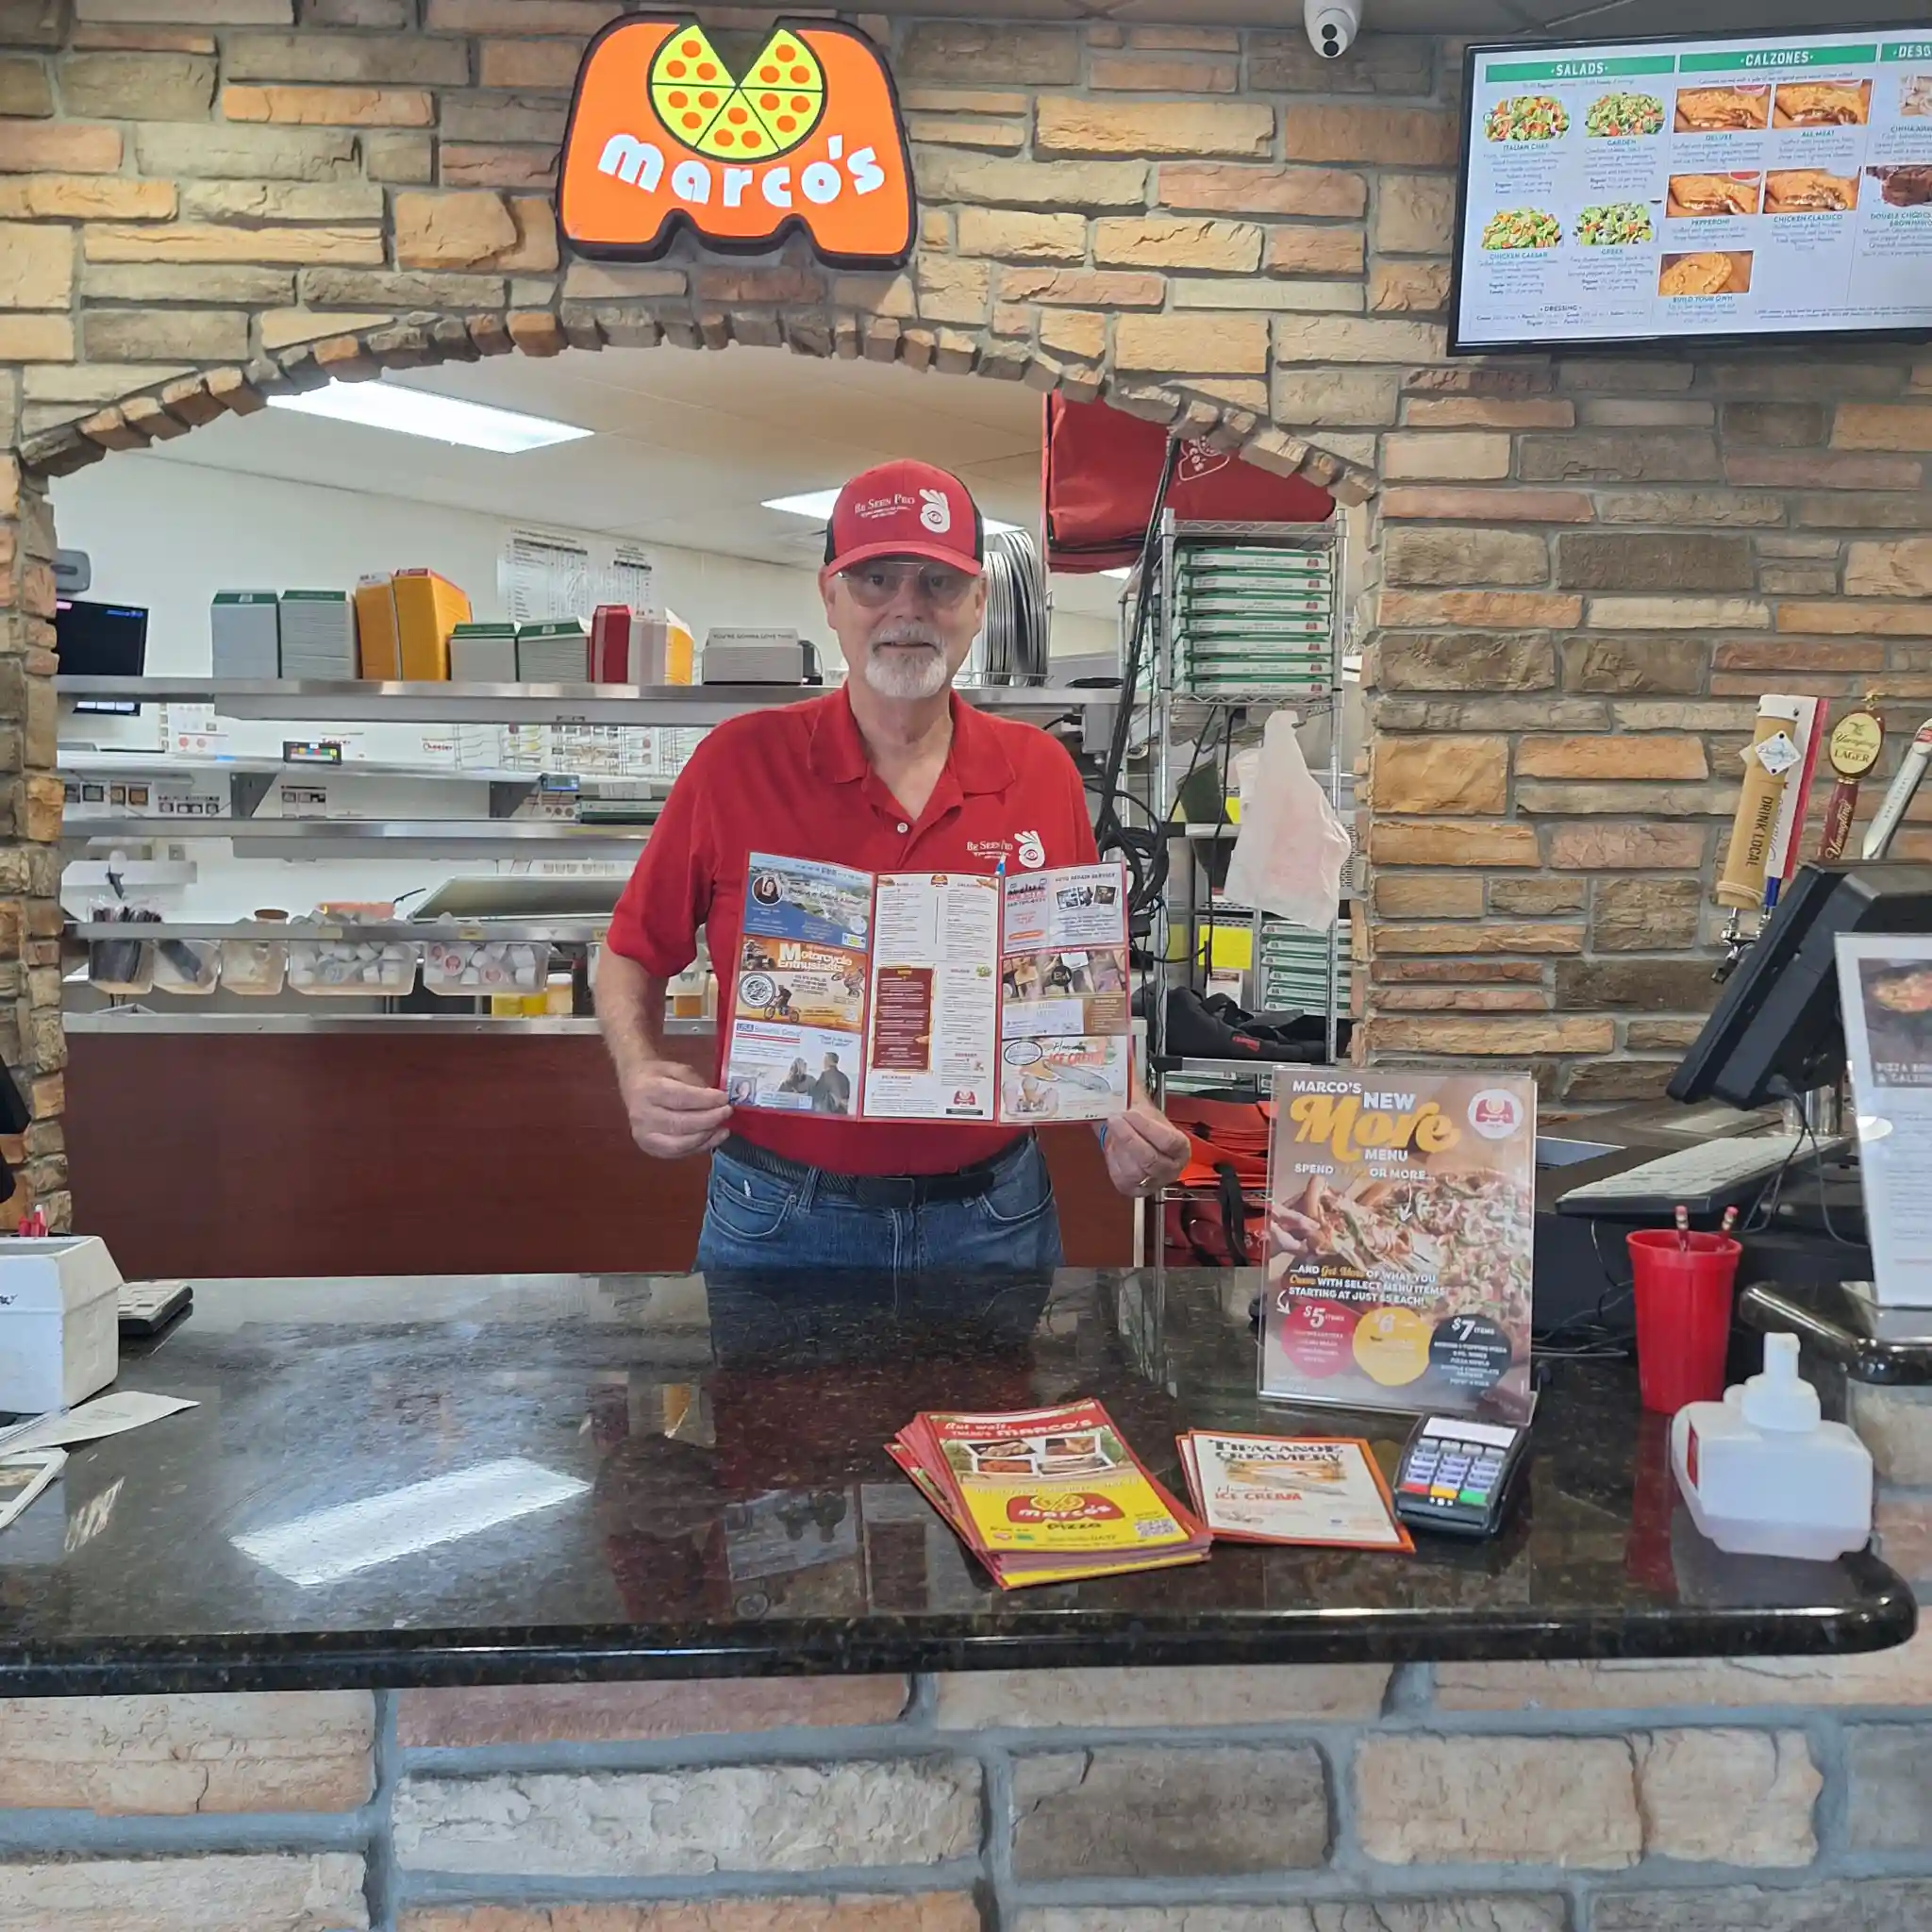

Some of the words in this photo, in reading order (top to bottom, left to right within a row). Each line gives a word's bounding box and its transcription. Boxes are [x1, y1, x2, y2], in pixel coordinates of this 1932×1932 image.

[1745, 51, 1809, 66] CALZONES
[1556, 62, 1604, 76] SALADS
[1834, 750, 1872, 763] LAGER
[1754, 795, 1774, 833] DRINK
[1745, 833, 1765, 867] LOCAL
[1292, 1080, 1362, 1094] MARCO'S
[1363, 1091, 1417, 1109] NEW
[1290, 1094, 1460, 1162] More
[1364, 1148, 1408, 1162] MENU
[1294, 1163, 1334, 1175] SPEND
[1369, 1166, 1388, 1178] OR
[1317, 1276, 1343, 1288] WITH
[1344, 1279, 1383, 1291] SELECT
[1414, 1285, 1446, 1297] ITEMS
[1414, 1273, 1436, 1283] YOU
[1289, 1286, 1338, 1299] STARTING
[1338, 1291, 1352, 1301] AT
[1352, 1292, 1379, 1303] JUST
[1303, 1305, 1326, 1328] $5
[1451, 1316, 1476, 1341] $7
[1474, 1326, 1495, 1336] ITEMS
